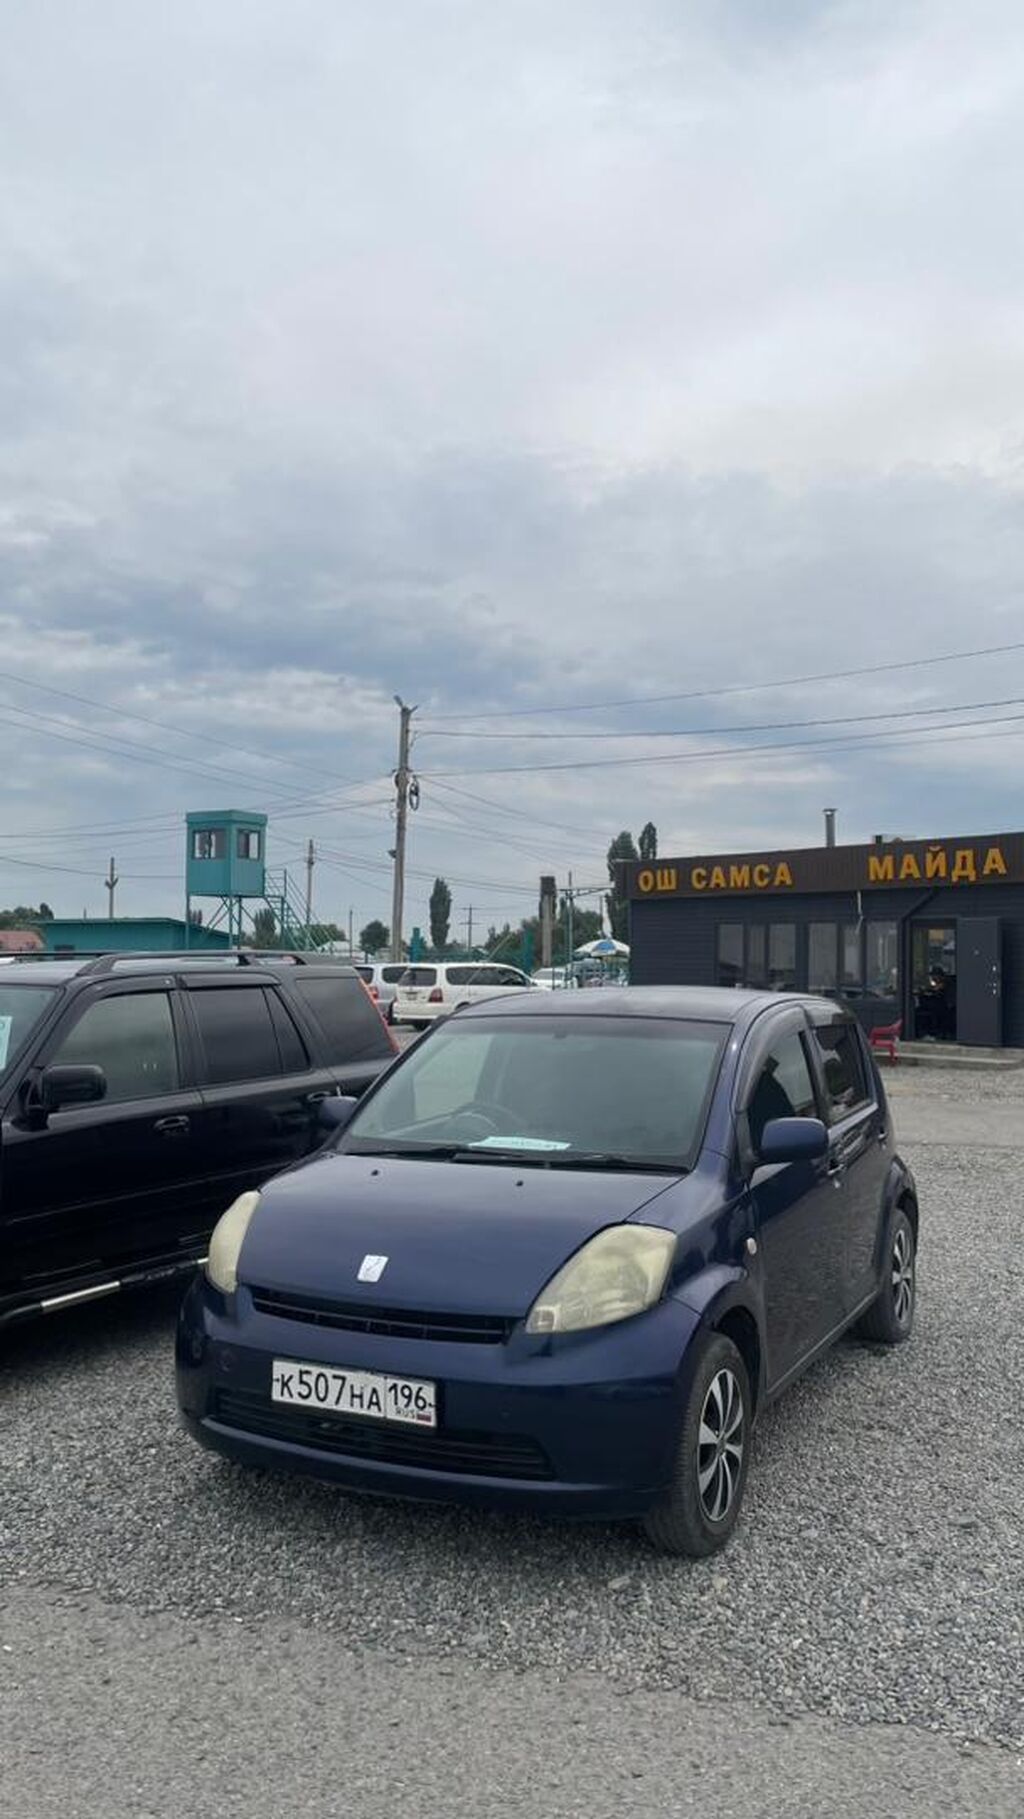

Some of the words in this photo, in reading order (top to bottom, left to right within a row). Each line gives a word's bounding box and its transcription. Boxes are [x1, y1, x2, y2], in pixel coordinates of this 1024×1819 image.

[638, 868, 677, 892] ОШ
[691, 862, 793, 890] САМСА
[868, 846, 1007, 882] МАЙДА
